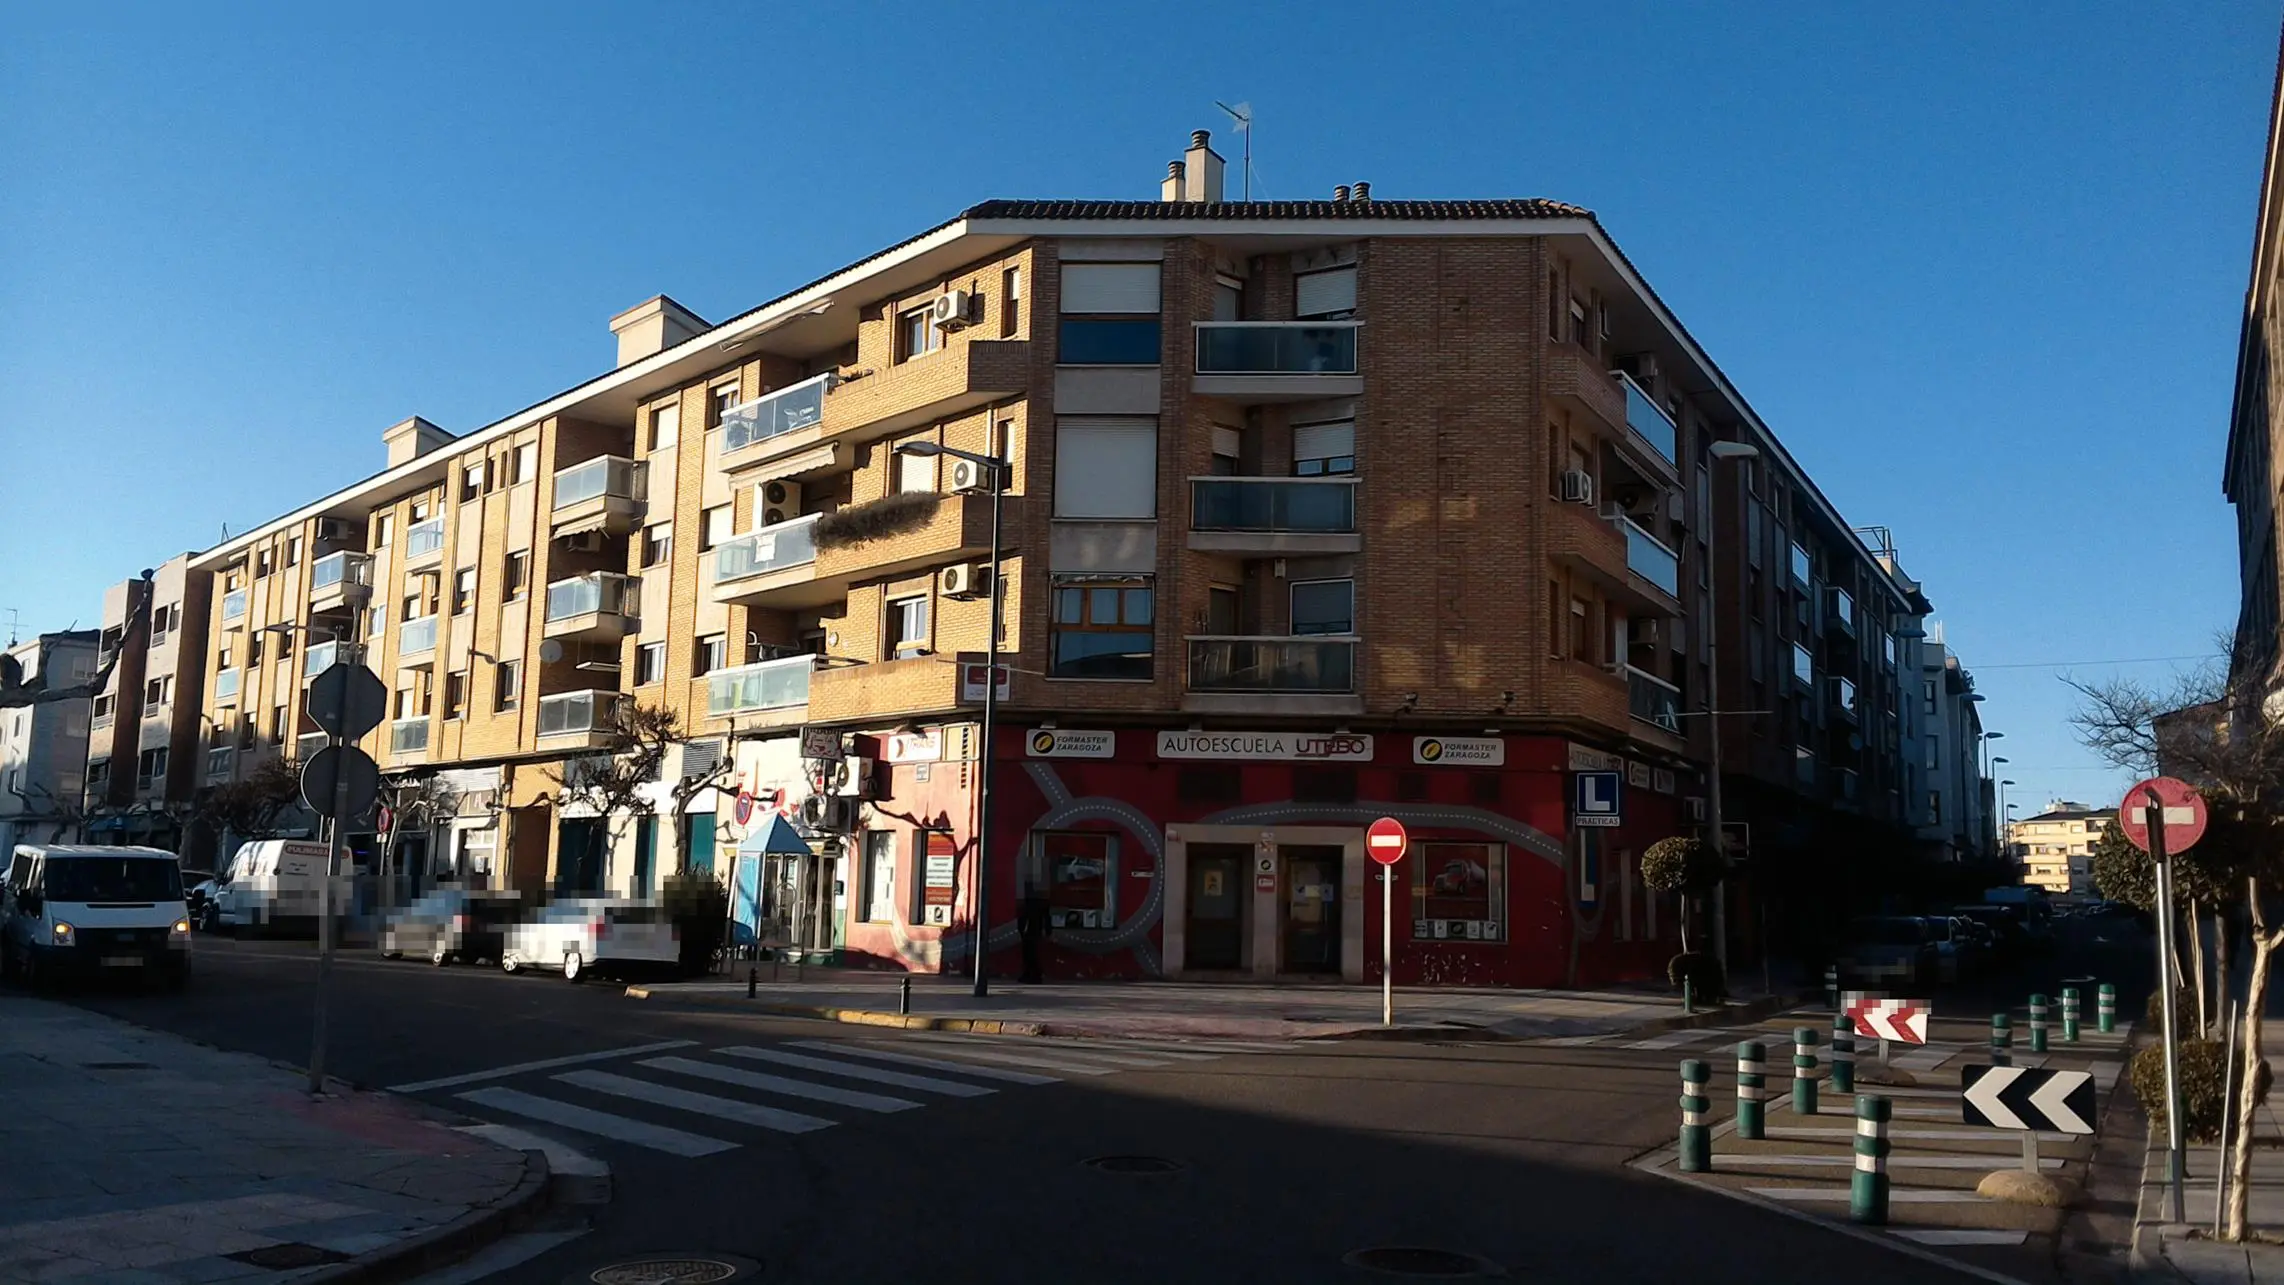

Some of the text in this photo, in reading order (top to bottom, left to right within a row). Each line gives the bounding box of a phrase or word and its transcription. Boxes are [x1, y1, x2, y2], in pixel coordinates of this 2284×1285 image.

[1056, 743, 1102, 751] ZARAGOZA
[1164, 738, 1285, 754] AUTOESCUELA
[1444, 743, 1496, 751] FORMASTER
[1444, 751, 1490, 759] ZARAGOZA
